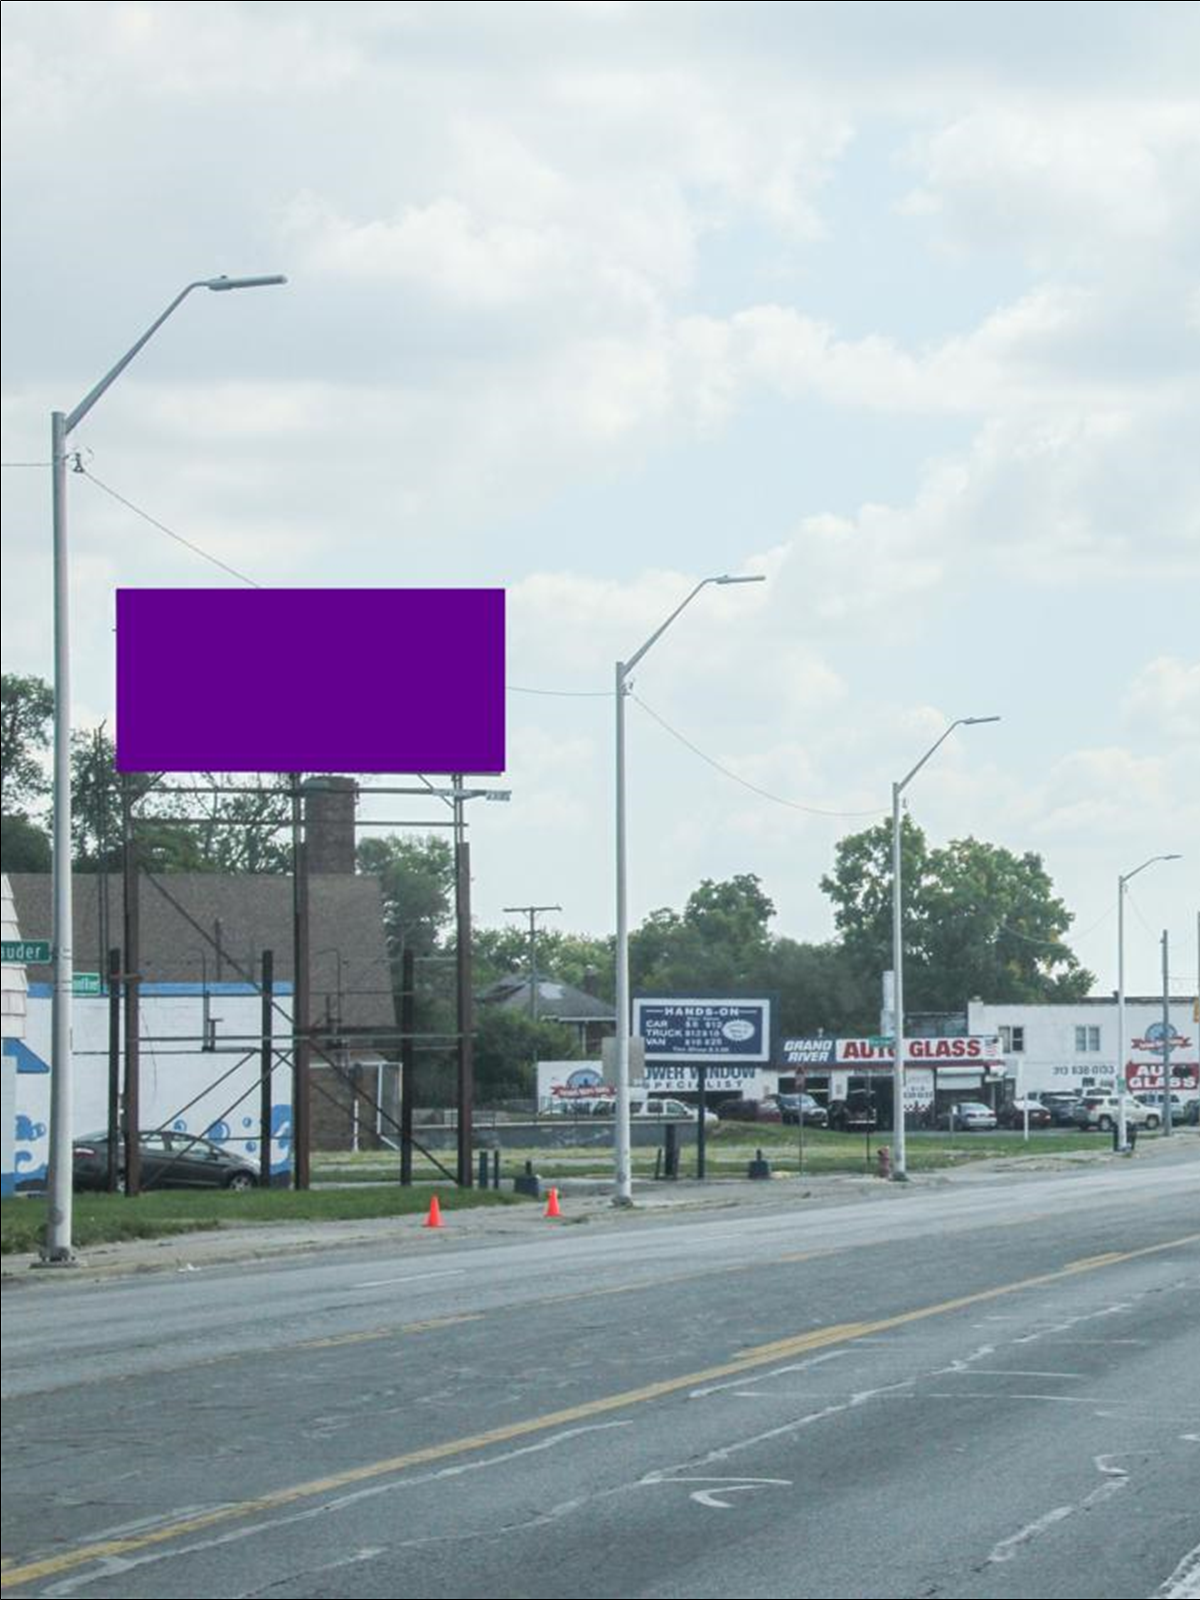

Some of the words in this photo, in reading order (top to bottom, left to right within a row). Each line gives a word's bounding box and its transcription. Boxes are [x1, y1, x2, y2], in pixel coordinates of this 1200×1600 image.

[664, 1008, 739, 1016] HANDS-ON
[646, 1029, 682, 1038] TRUCK
[646, 1038, 666, 1046] VAN
[784, 1040, 833, 1051] GRAND
[909, 1040, 981, 1057] GLASS
[788, 1051, 829, 1062] RIVER
